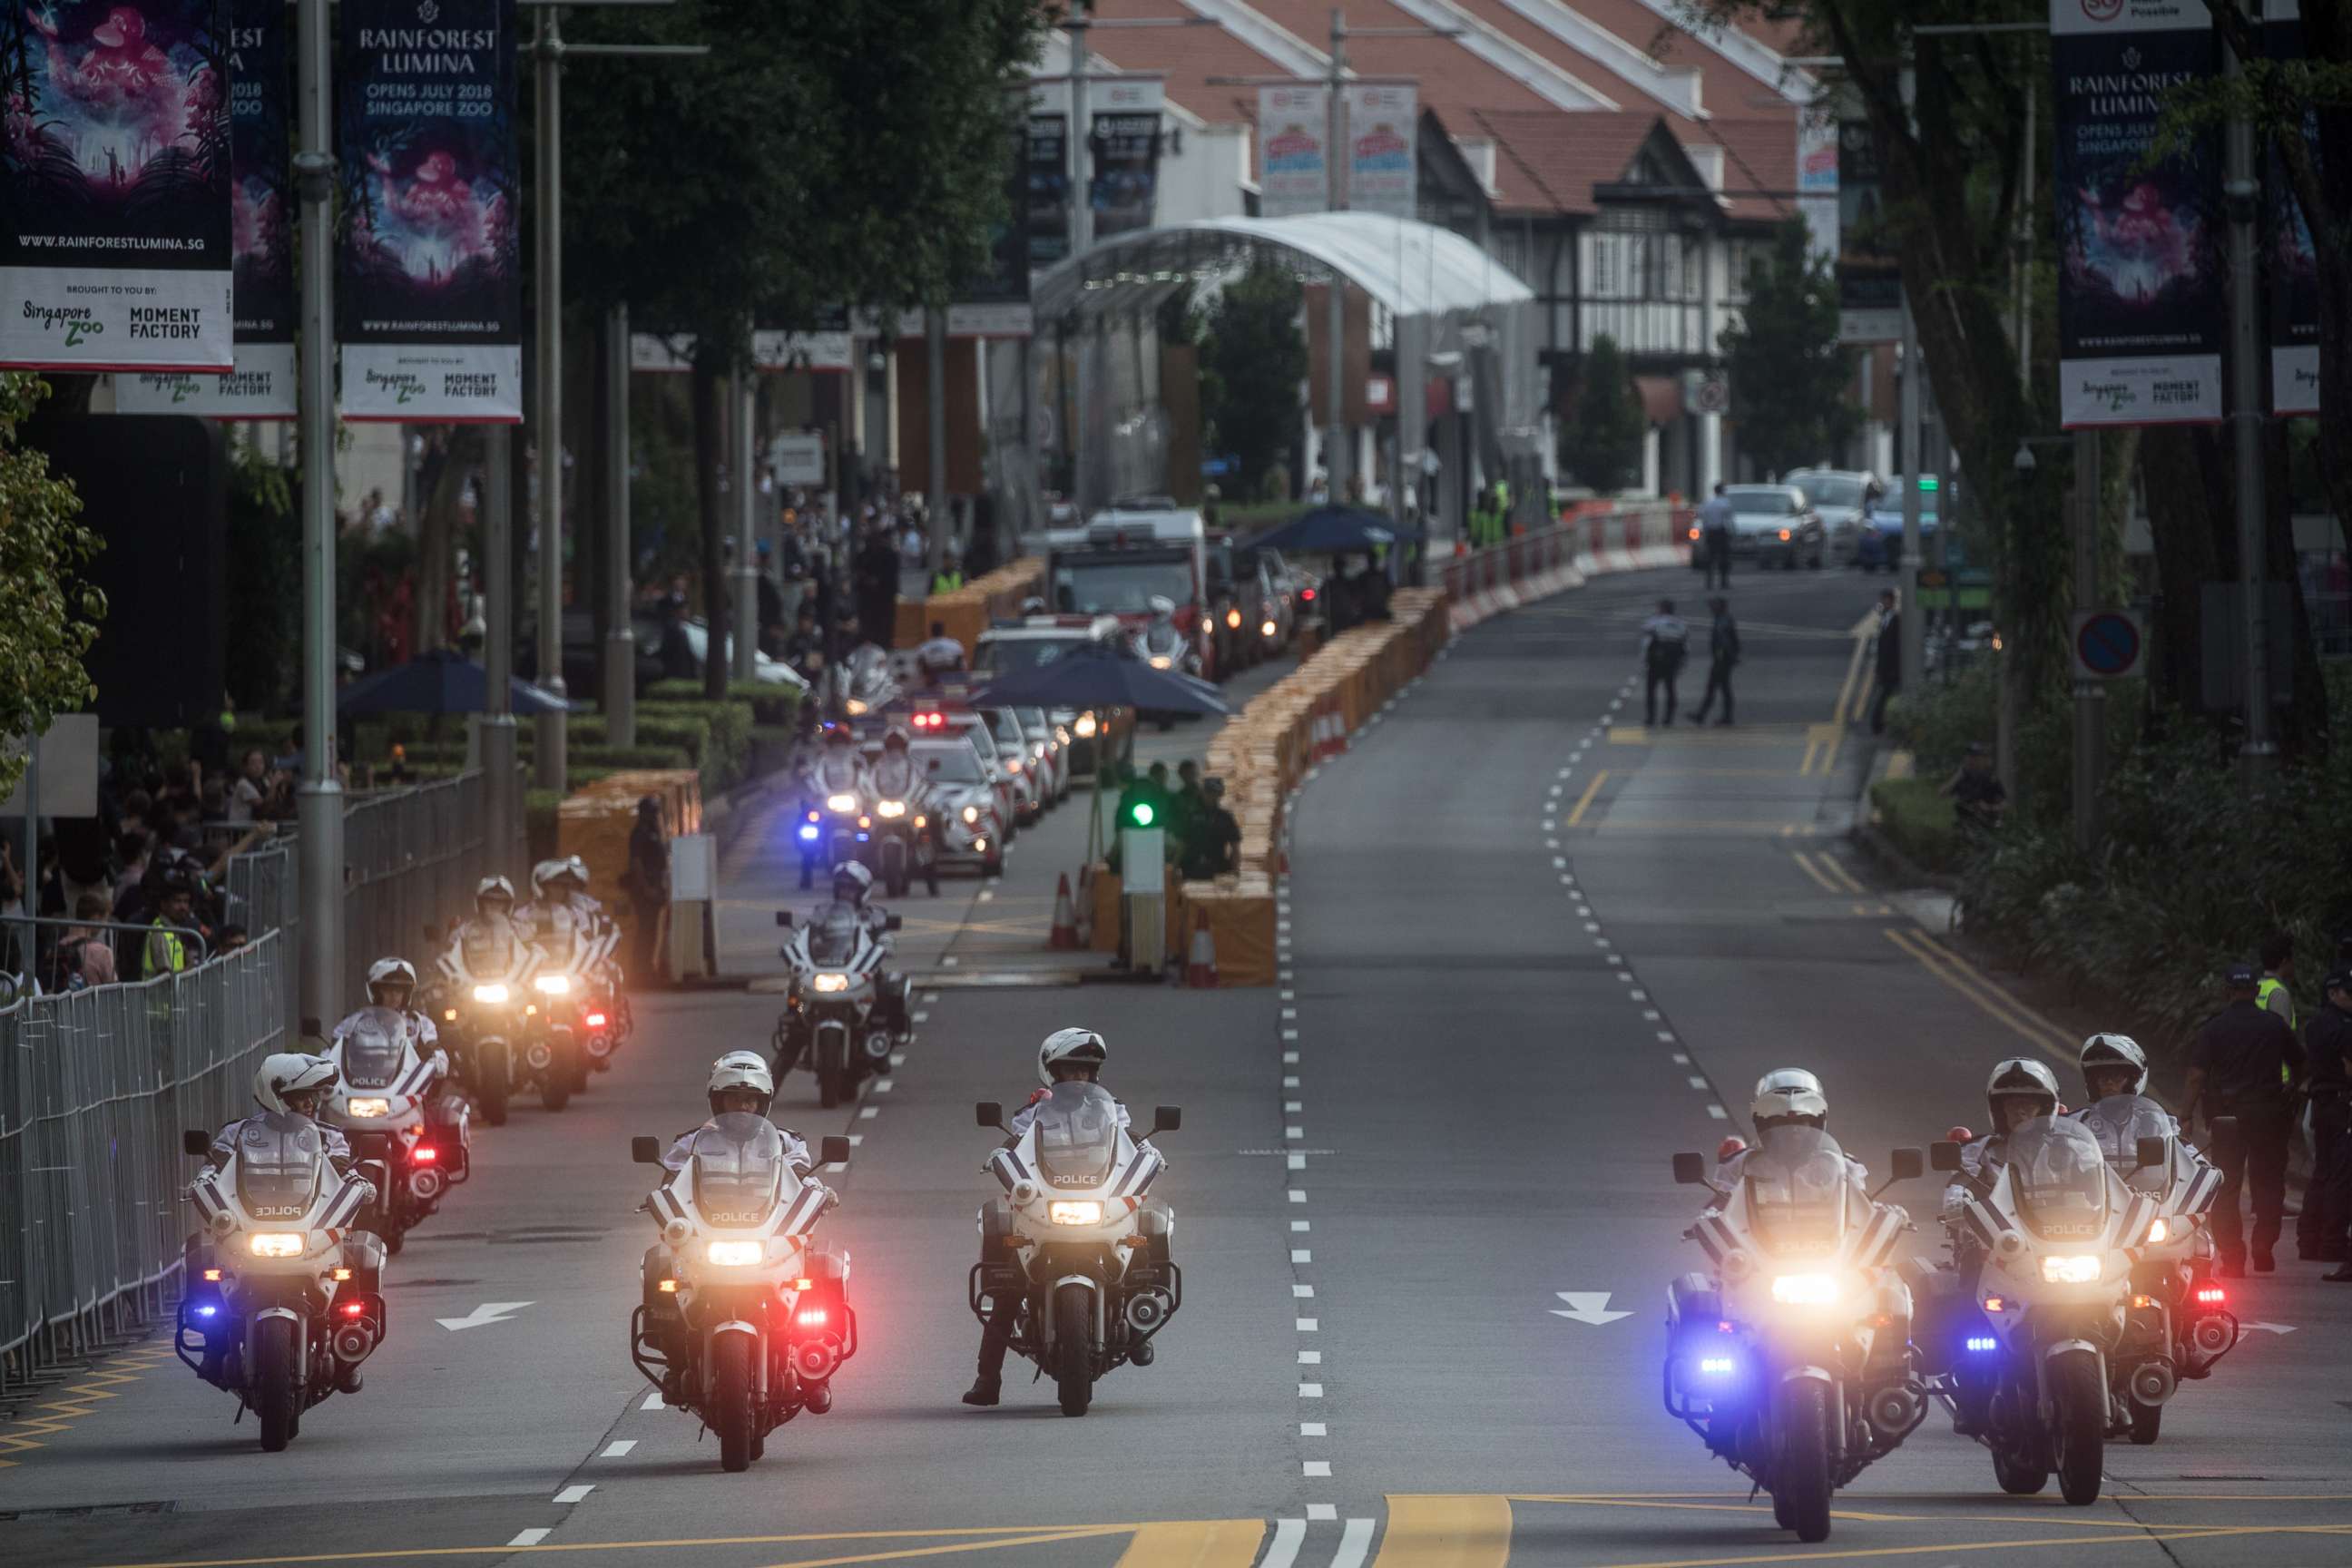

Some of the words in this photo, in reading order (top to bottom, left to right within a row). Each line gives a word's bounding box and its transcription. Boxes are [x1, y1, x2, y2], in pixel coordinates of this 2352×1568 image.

[360, 27, 496, 50] RAINFOREST
[381, 53, 475, 74] LUMINA
[365, 83, 417, 100] OPENS
[420, 83, 454, 100] JULY
[456, 83, 493, 100] 2018
[365, 101, 453, 116] SINGAPORE
[456, 101, 494, 116] ZOO
[2090, 93, 2160, 116] LUMIN
[2075, 122, 2123, 138] OPENS
[18, 235, 205, 250] WWW.RAINFORESTLUMINA.SG
[66, 285, 110, 295] BROUGHT
[111, 286, 122, 295] TO
[124, 286, 144, 295] YOU
[23, 300, 92, 330] Singapore
[130, 309, 201, 323] MOMENT
[64, 320, 103, 348] Zoo
[130, 324, 201, 338] FACTORY
[445, 373, 497, 383] MOMENT
[219, 383, 271, 396] FACTORY
[445, 385, 497, 397] FACTORY
[351, 1076, 387, 1087] POLICE
[1053, 1175, 1098, 1185] POLICE
[711, 1212, 760, 1222] POLICE
[2043, 1224, 2094, 1235] POLICE
